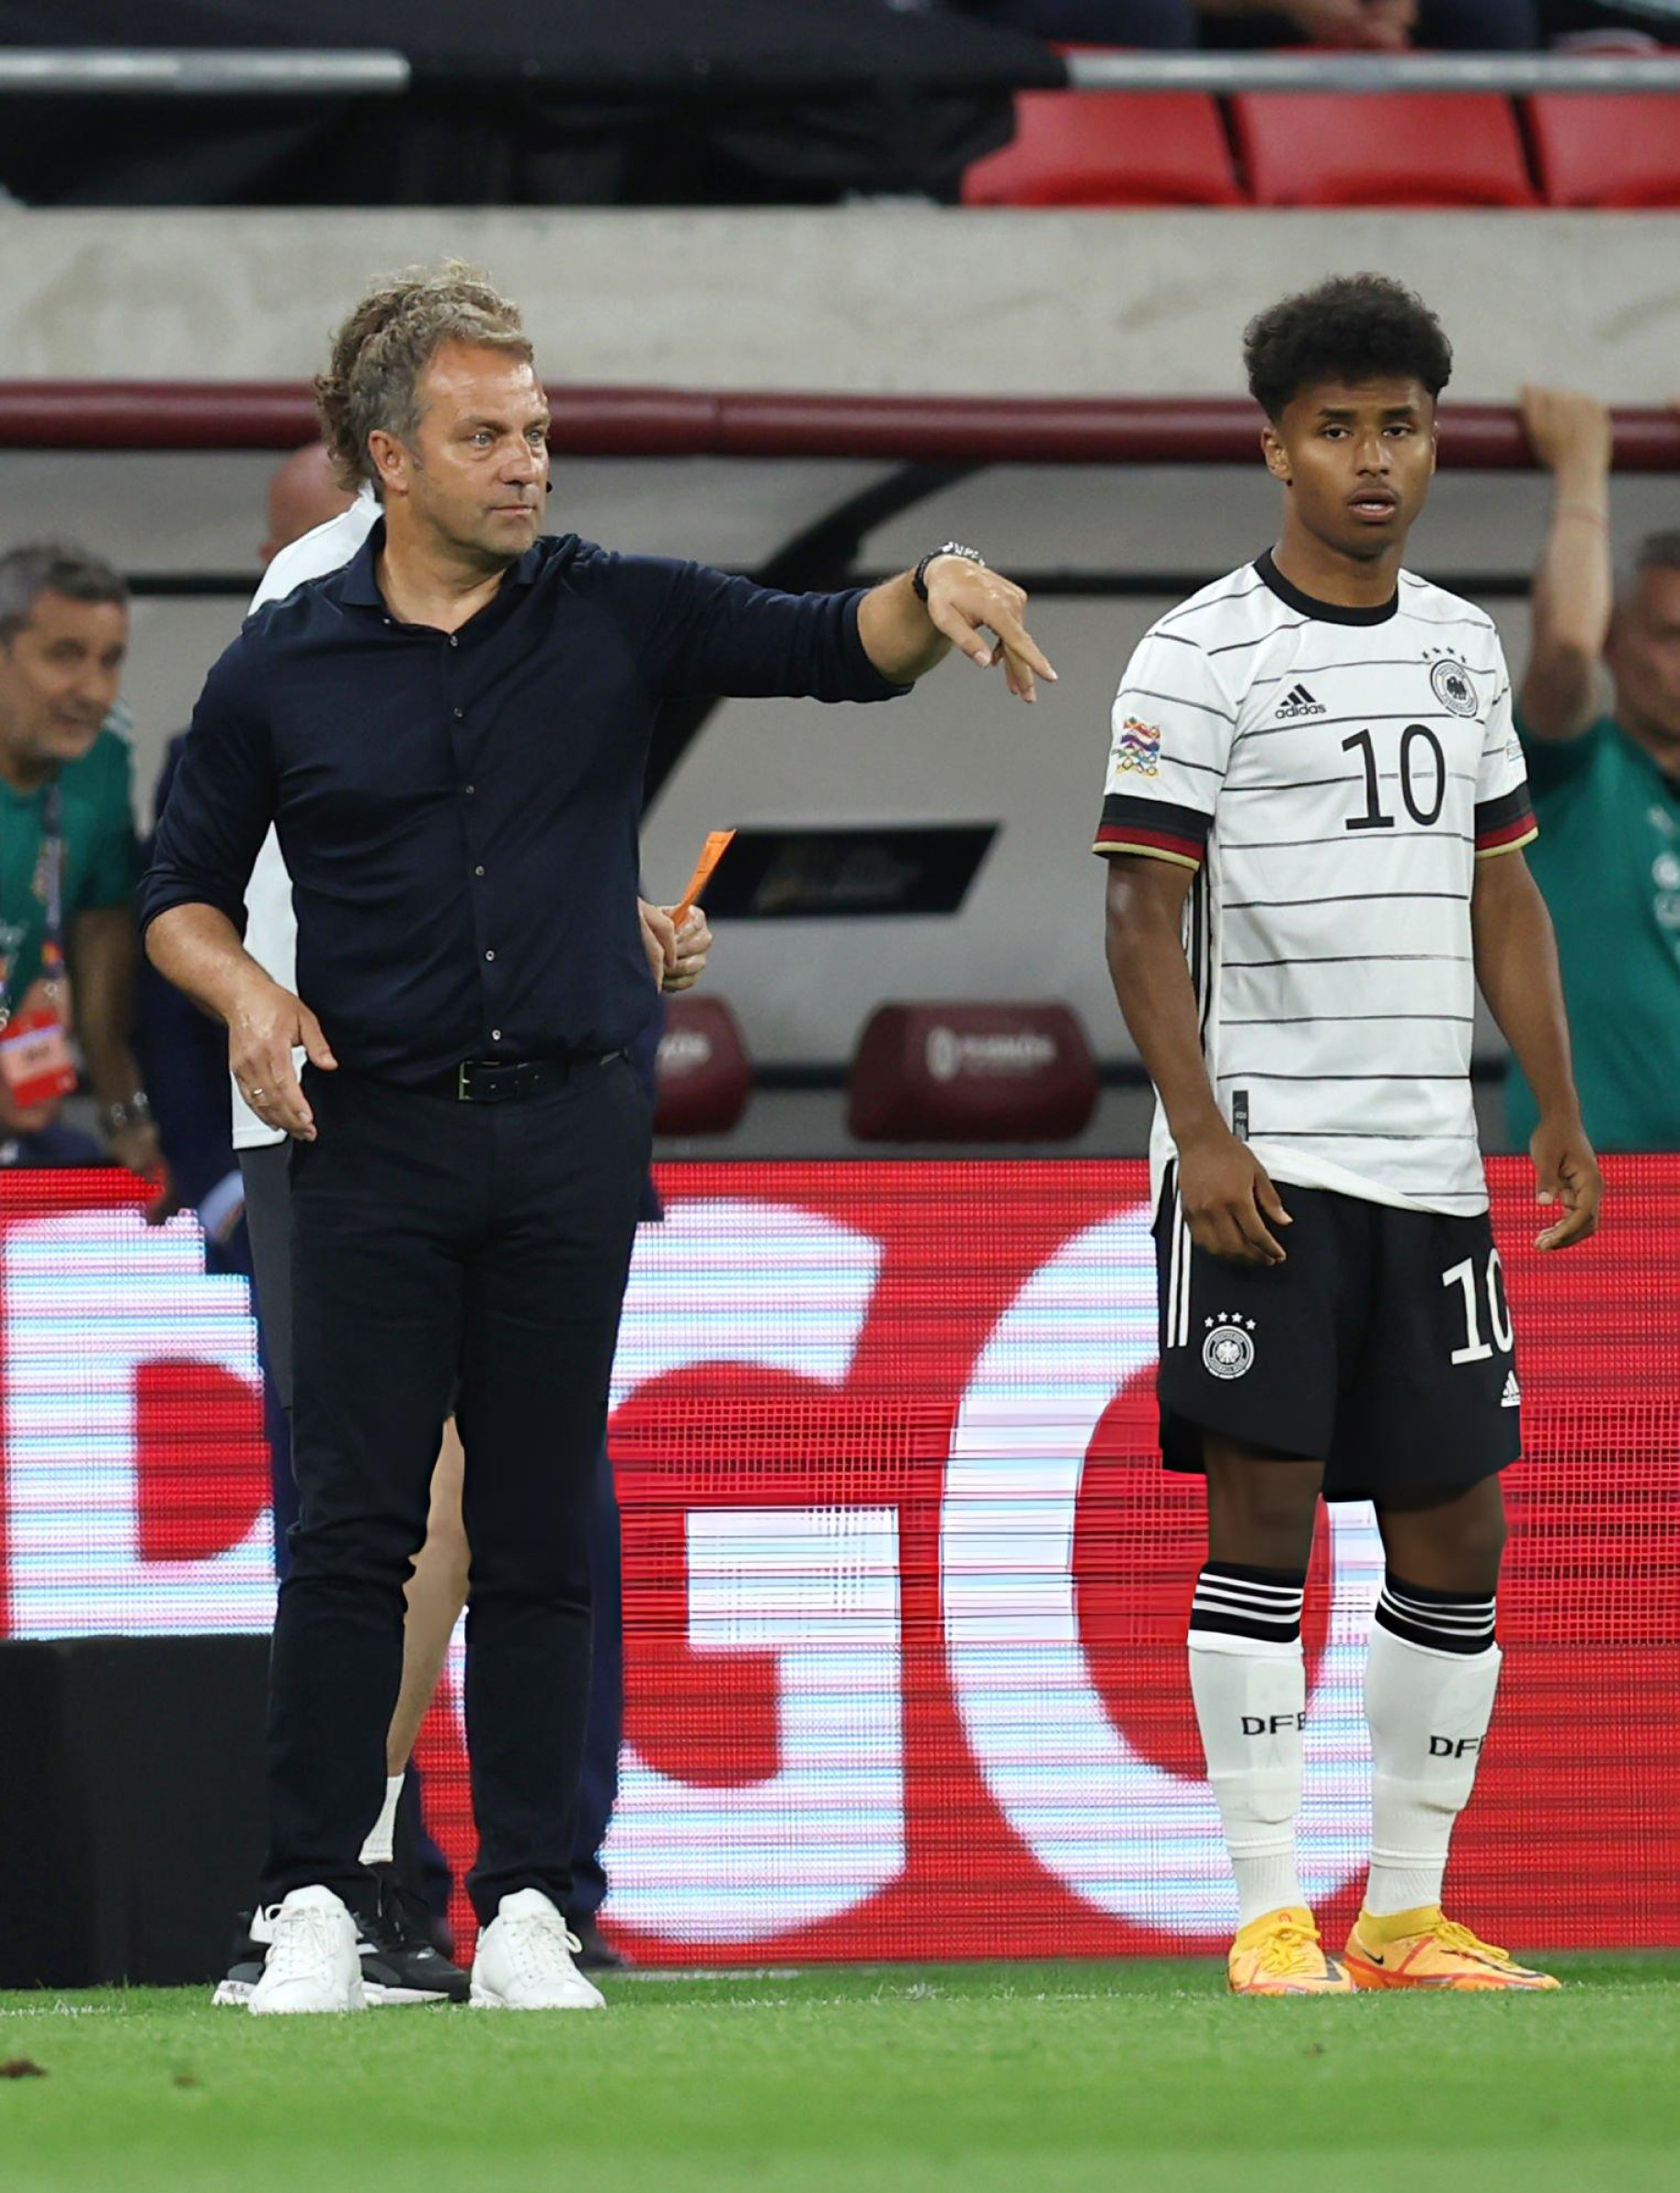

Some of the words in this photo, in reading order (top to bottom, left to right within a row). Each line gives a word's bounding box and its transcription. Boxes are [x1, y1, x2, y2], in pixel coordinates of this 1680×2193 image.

[1275, 702, 1326, 719] adidas
[1342, 724, 1446, 830] 10
[1442, 1247, 1514, 1365] 10
